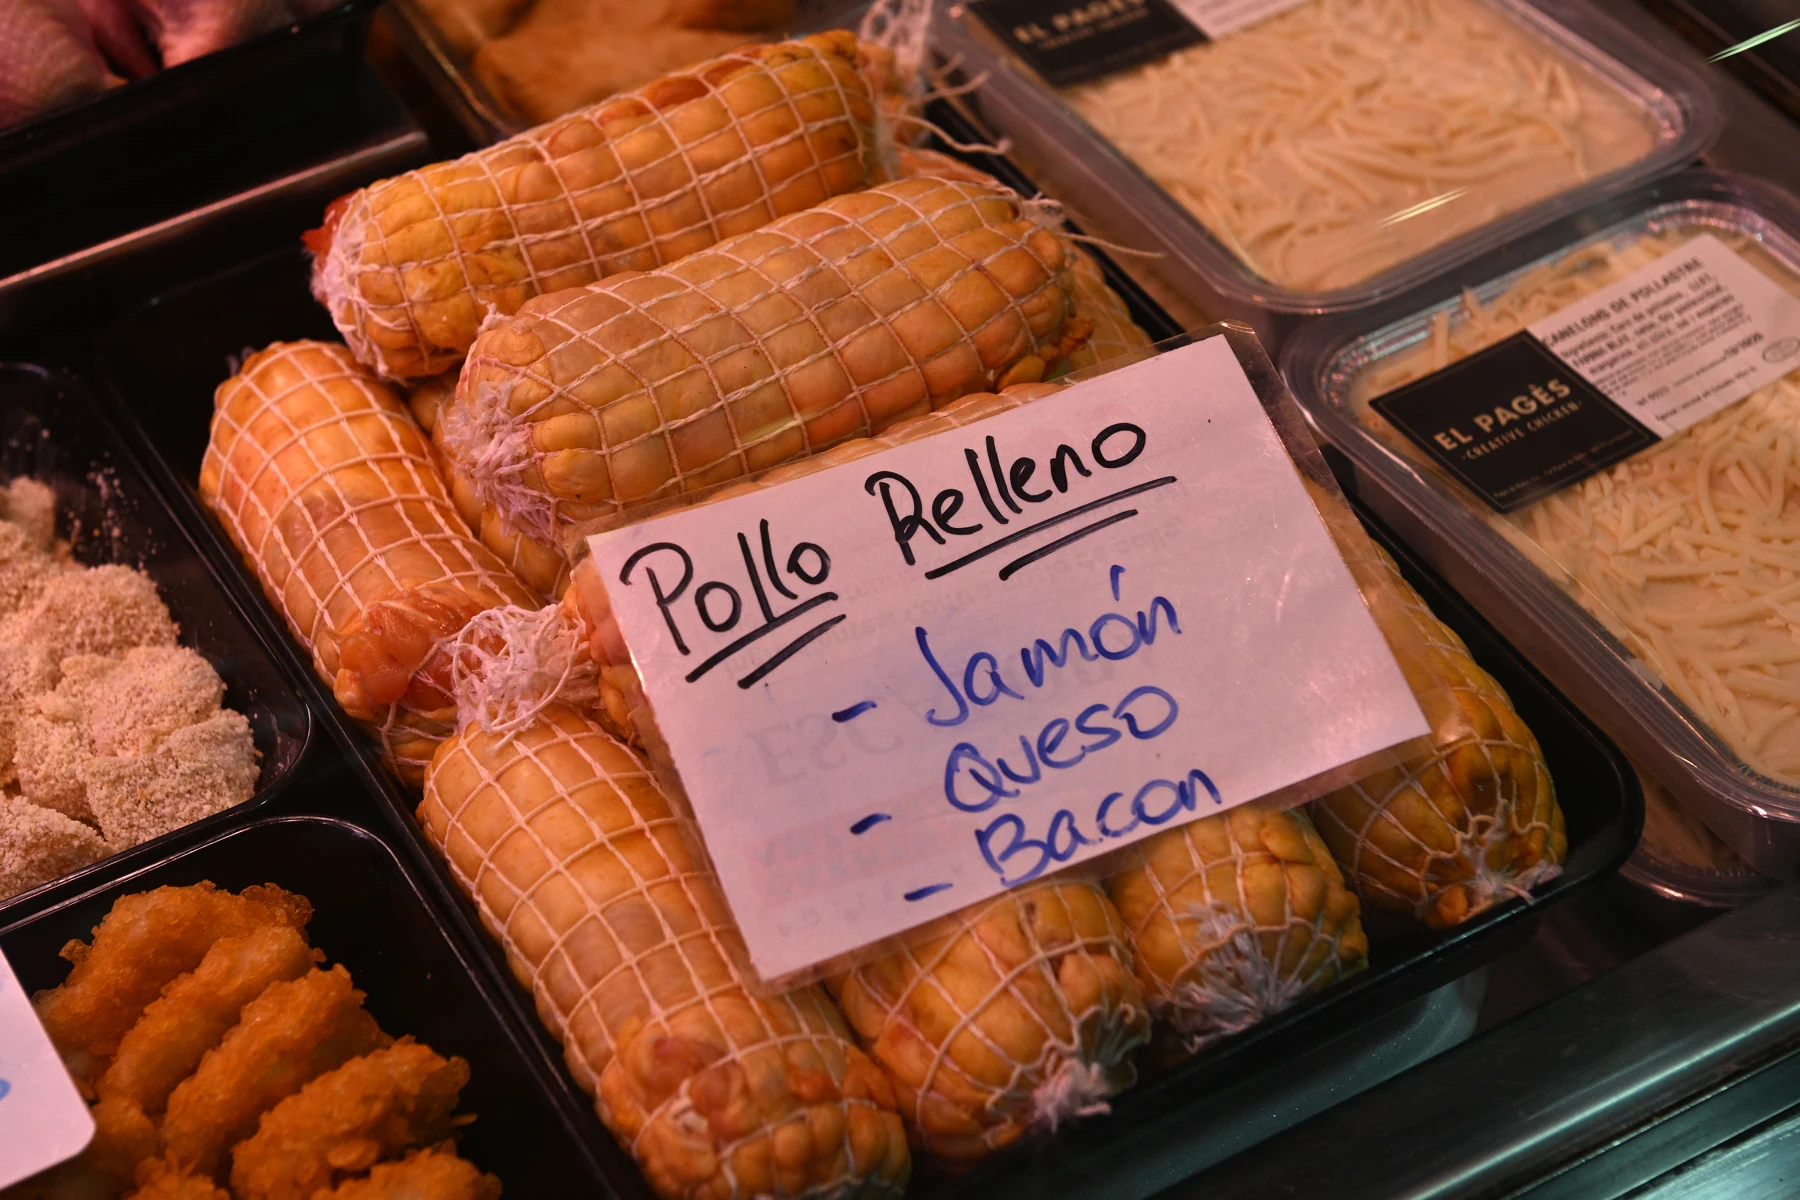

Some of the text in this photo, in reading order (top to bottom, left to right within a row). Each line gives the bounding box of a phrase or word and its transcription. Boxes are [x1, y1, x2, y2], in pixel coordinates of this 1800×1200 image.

[1433, 427, 1473, 450] EL
[620, 423, 1147, 654] Pollo Relleno
[916, 565, 1183, 728] Jamón
[943, 685, 1179, 814] Queso
[976, 767, 1223, 888] Bacon
